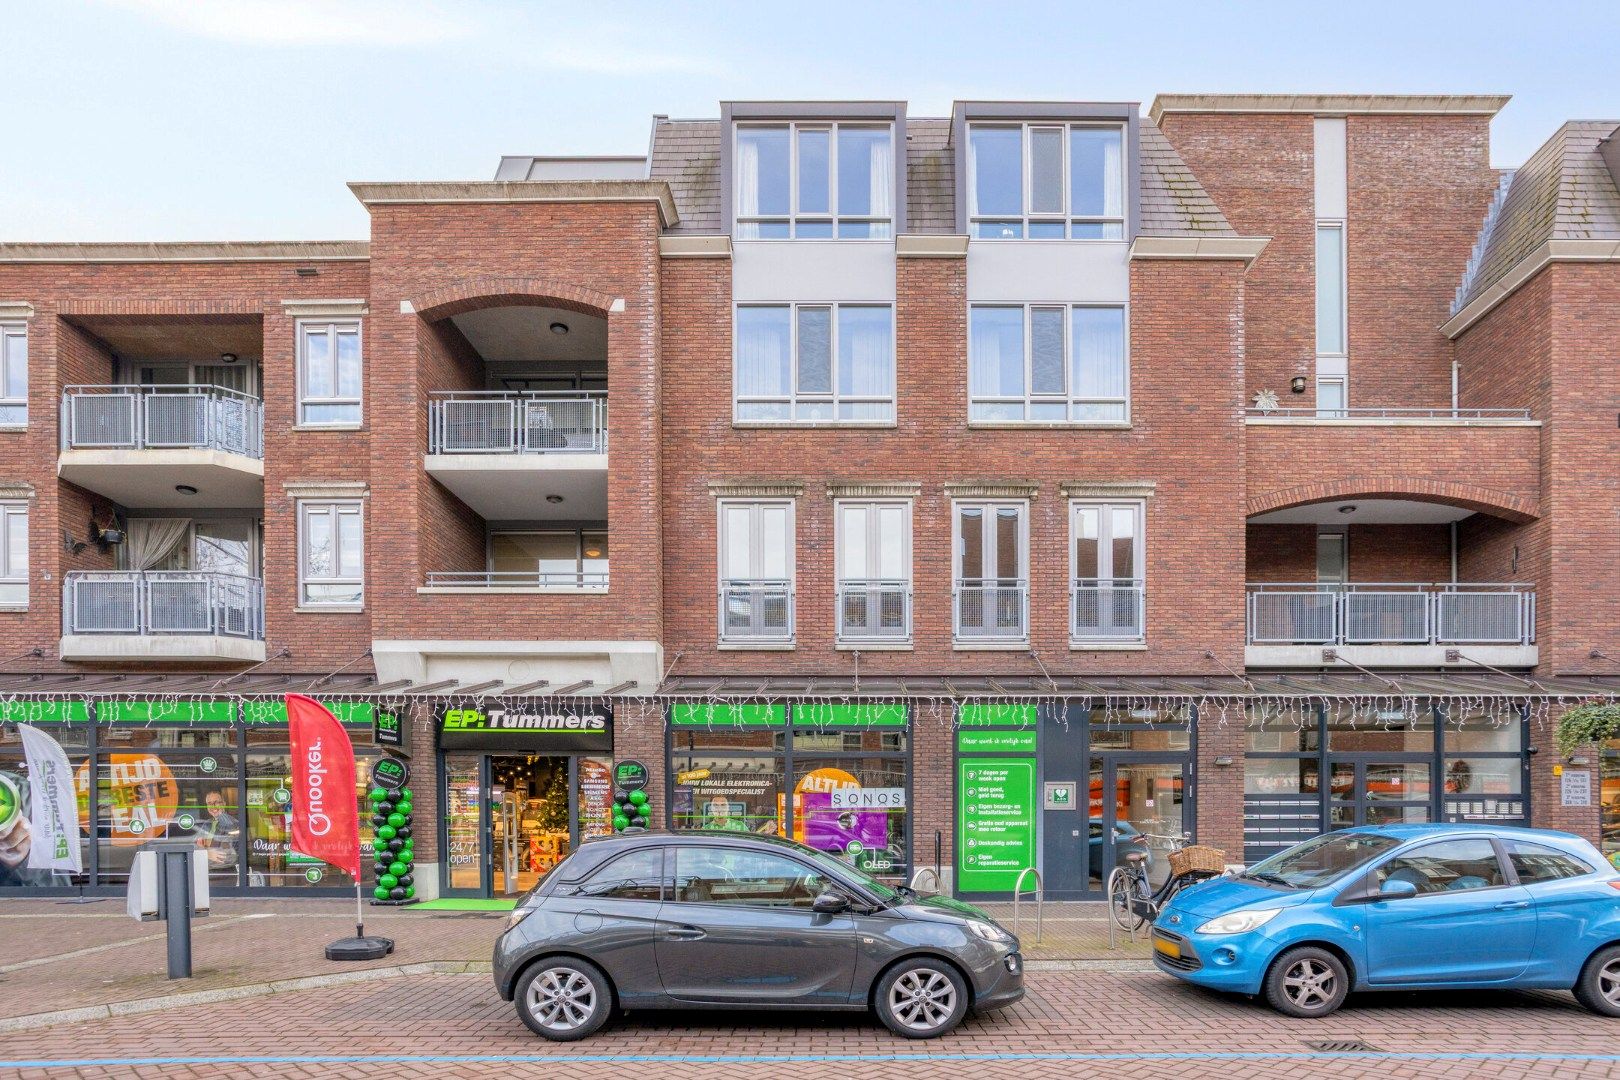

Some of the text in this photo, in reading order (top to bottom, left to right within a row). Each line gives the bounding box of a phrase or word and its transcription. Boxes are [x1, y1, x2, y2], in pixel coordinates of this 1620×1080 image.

[379, 761, 403, 777] EP:
[618, 765, 642, 777] EP:
[308, 741, 331, 836] Quooker
[833, 793, 900, 804] SONOS
[253, 838, 280, 851] Daar
[449, 842, 474, 853] 24/7
[450, 854, 475, 865] open
